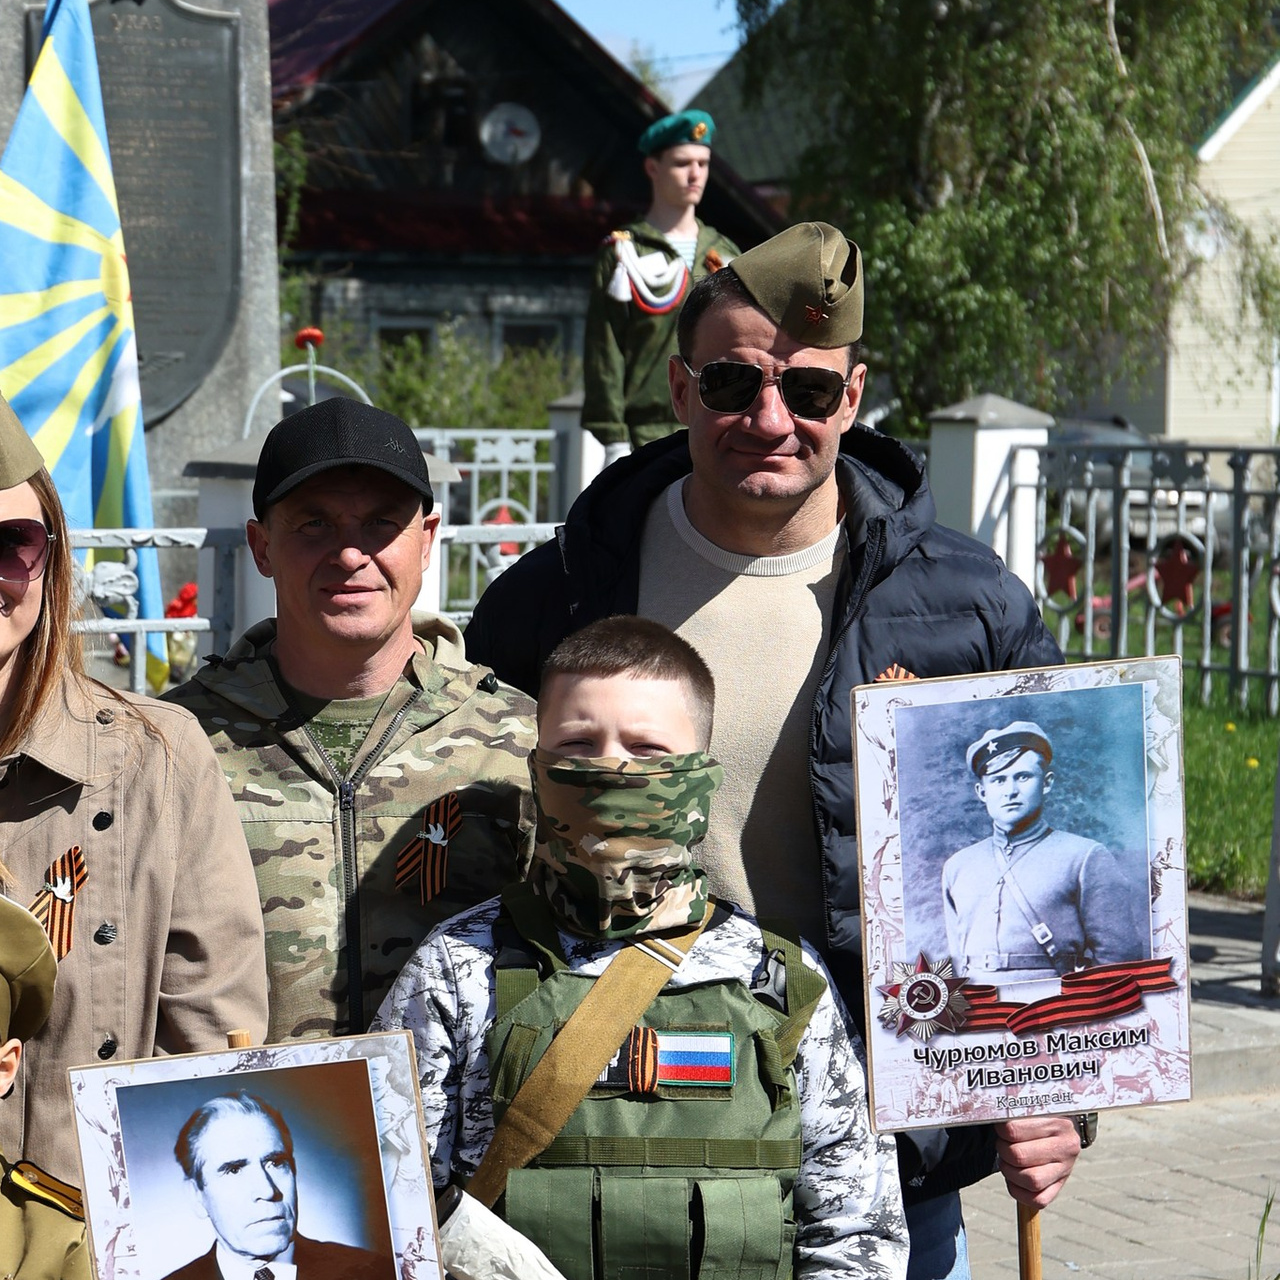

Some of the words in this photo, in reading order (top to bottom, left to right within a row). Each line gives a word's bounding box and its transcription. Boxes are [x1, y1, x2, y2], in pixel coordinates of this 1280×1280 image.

[913, 1039, 1037, 1070] Чурюмов
[1046, 1027, 1148, 1054] Максим
[966, 1059, 1098, 1088] Иванович
[995, 1090, 1073, 1109] Капитан
